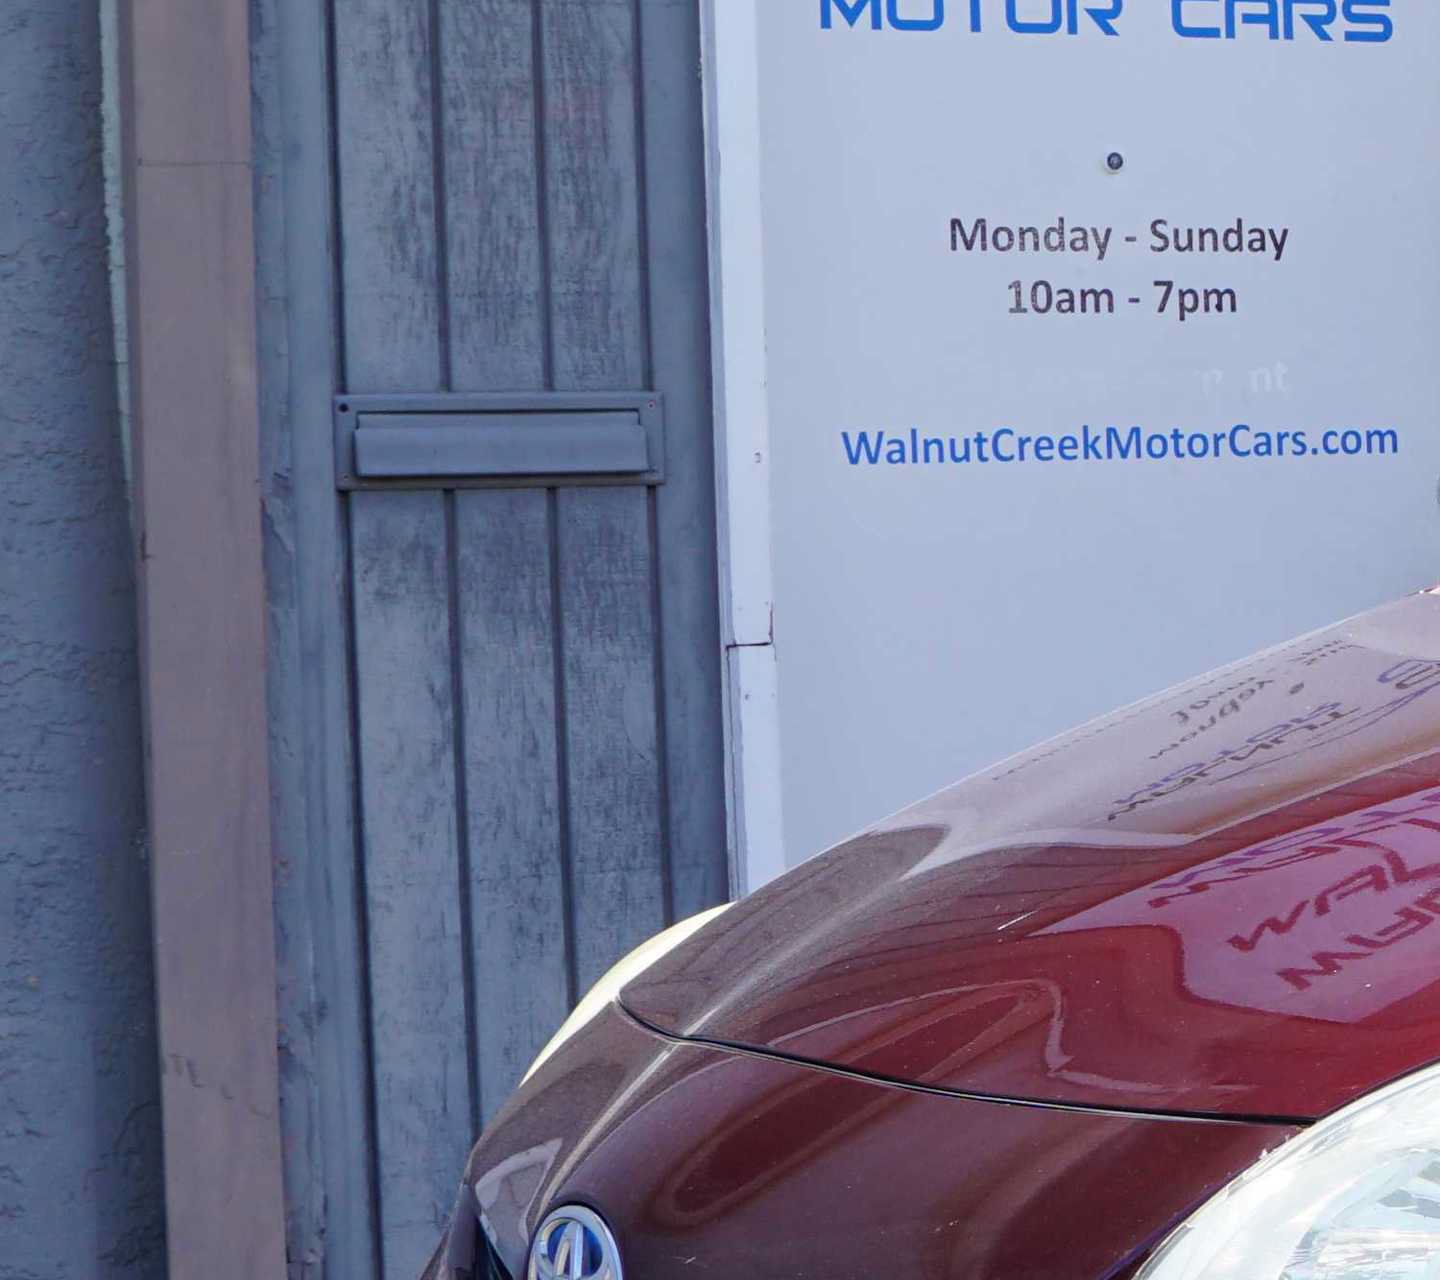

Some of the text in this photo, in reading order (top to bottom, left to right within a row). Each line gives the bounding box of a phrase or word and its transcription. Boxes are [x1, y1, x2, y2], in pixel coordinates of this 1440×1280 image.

[949, 217, 1112, 261] Monday
[1149, 217, 1289, 261] Sunday
[1007, 279, 1115, 315] 10am
[1152, 279, 1238, 322] 7pm
[841, 424, 1399, 466] WalnutCreekMotorCars.com
